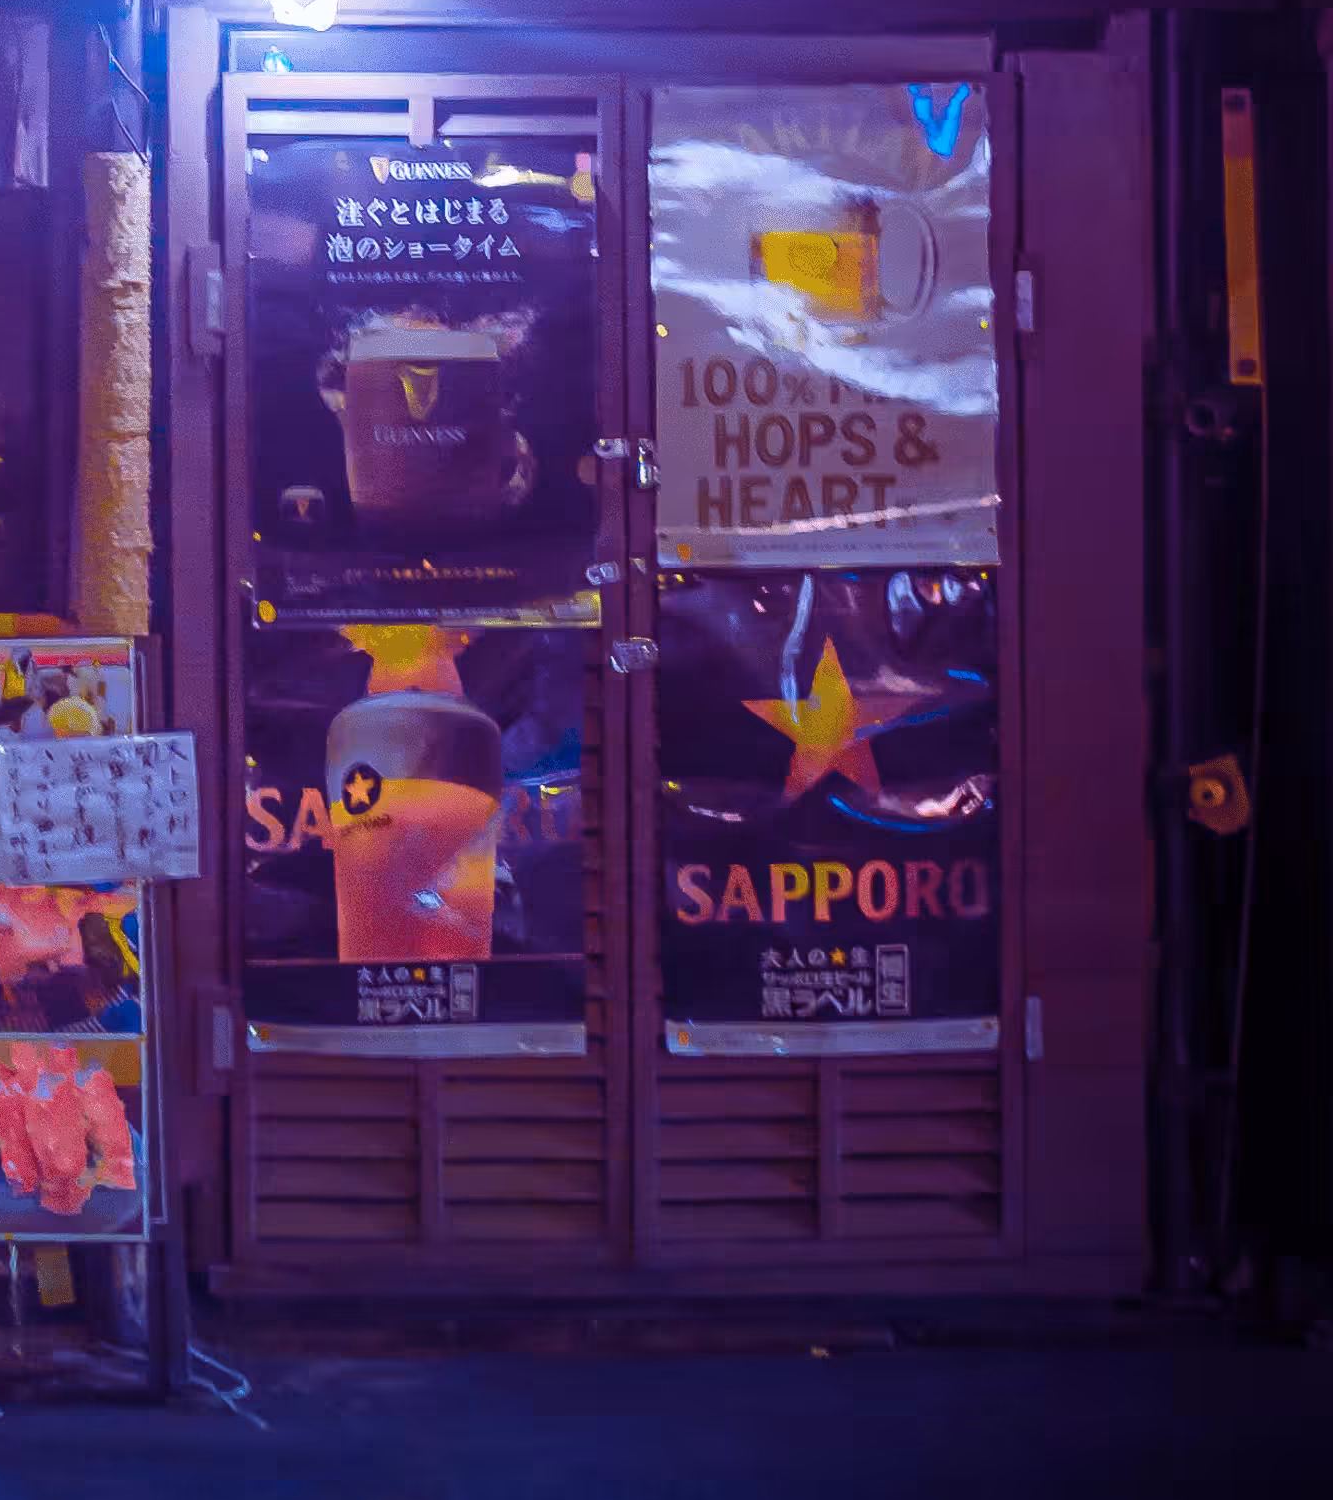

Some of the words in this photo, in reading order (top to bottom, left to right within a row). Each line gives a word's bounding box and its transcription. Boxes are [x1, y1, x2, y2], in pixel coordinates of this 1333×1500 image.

[388, 160, 473, 181] GUINNESS
[335, 196, 510, 228] 注ぐとはじまる
[326, 232, 521, 263] 泡のショータイム
[713, 411, 878, 468] HOPS
[892, 411, 940, 467] &
[676, 859, 989, 924] SAPPORO
